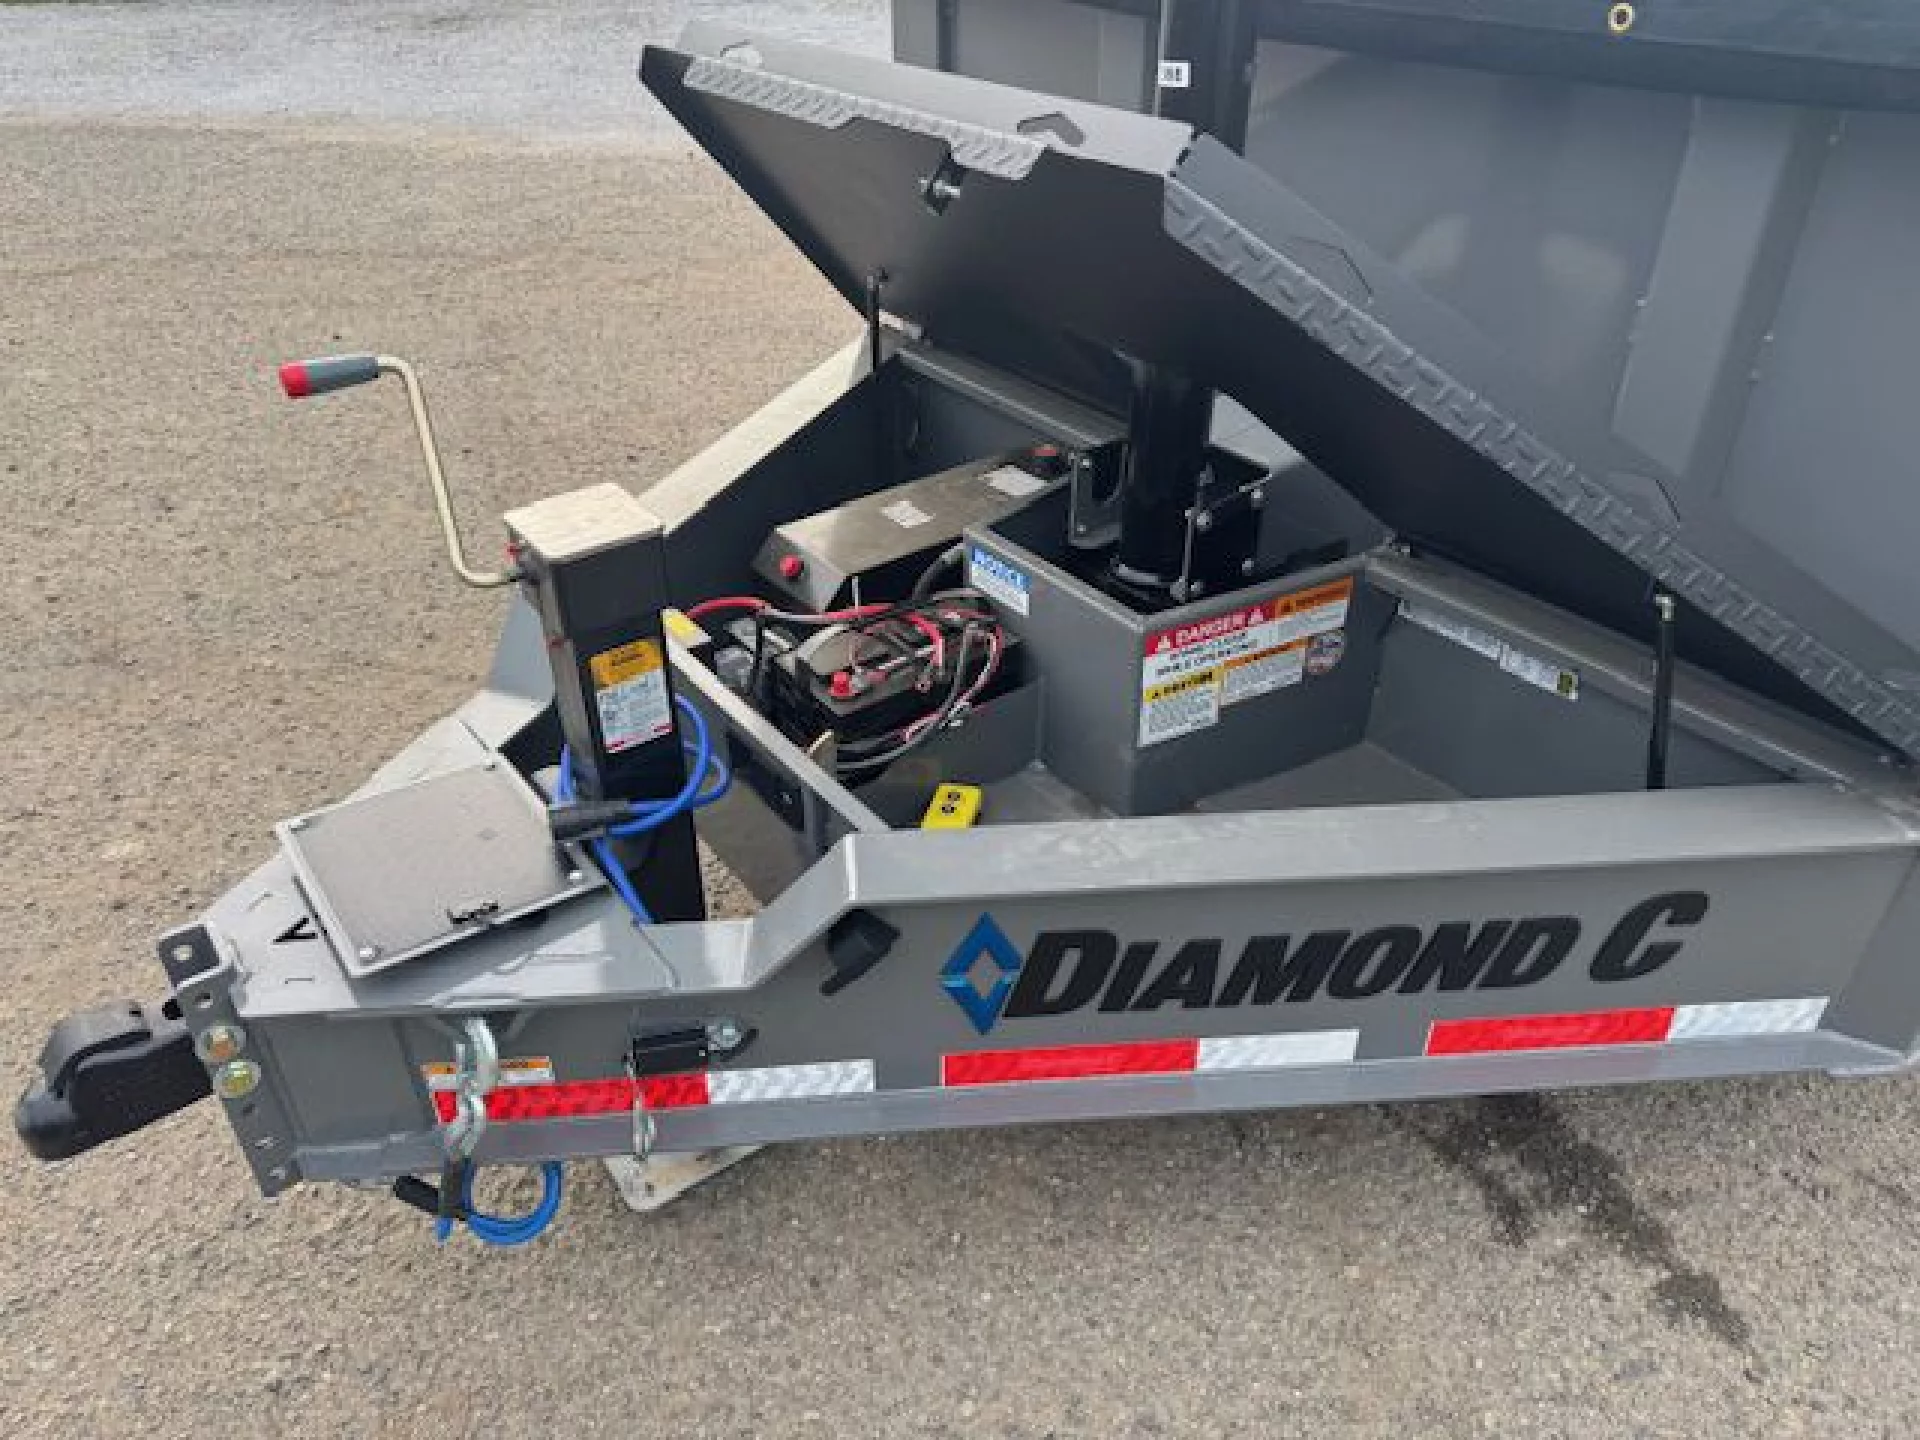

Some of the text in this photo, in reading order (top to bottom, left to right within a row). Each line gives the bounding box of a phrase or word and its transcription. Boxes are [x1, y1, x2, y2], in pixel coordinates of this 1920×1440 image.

[1175, 611, 1246, 645] DANGER
[1002, 890, 1710, 1020] DIAMOND C
